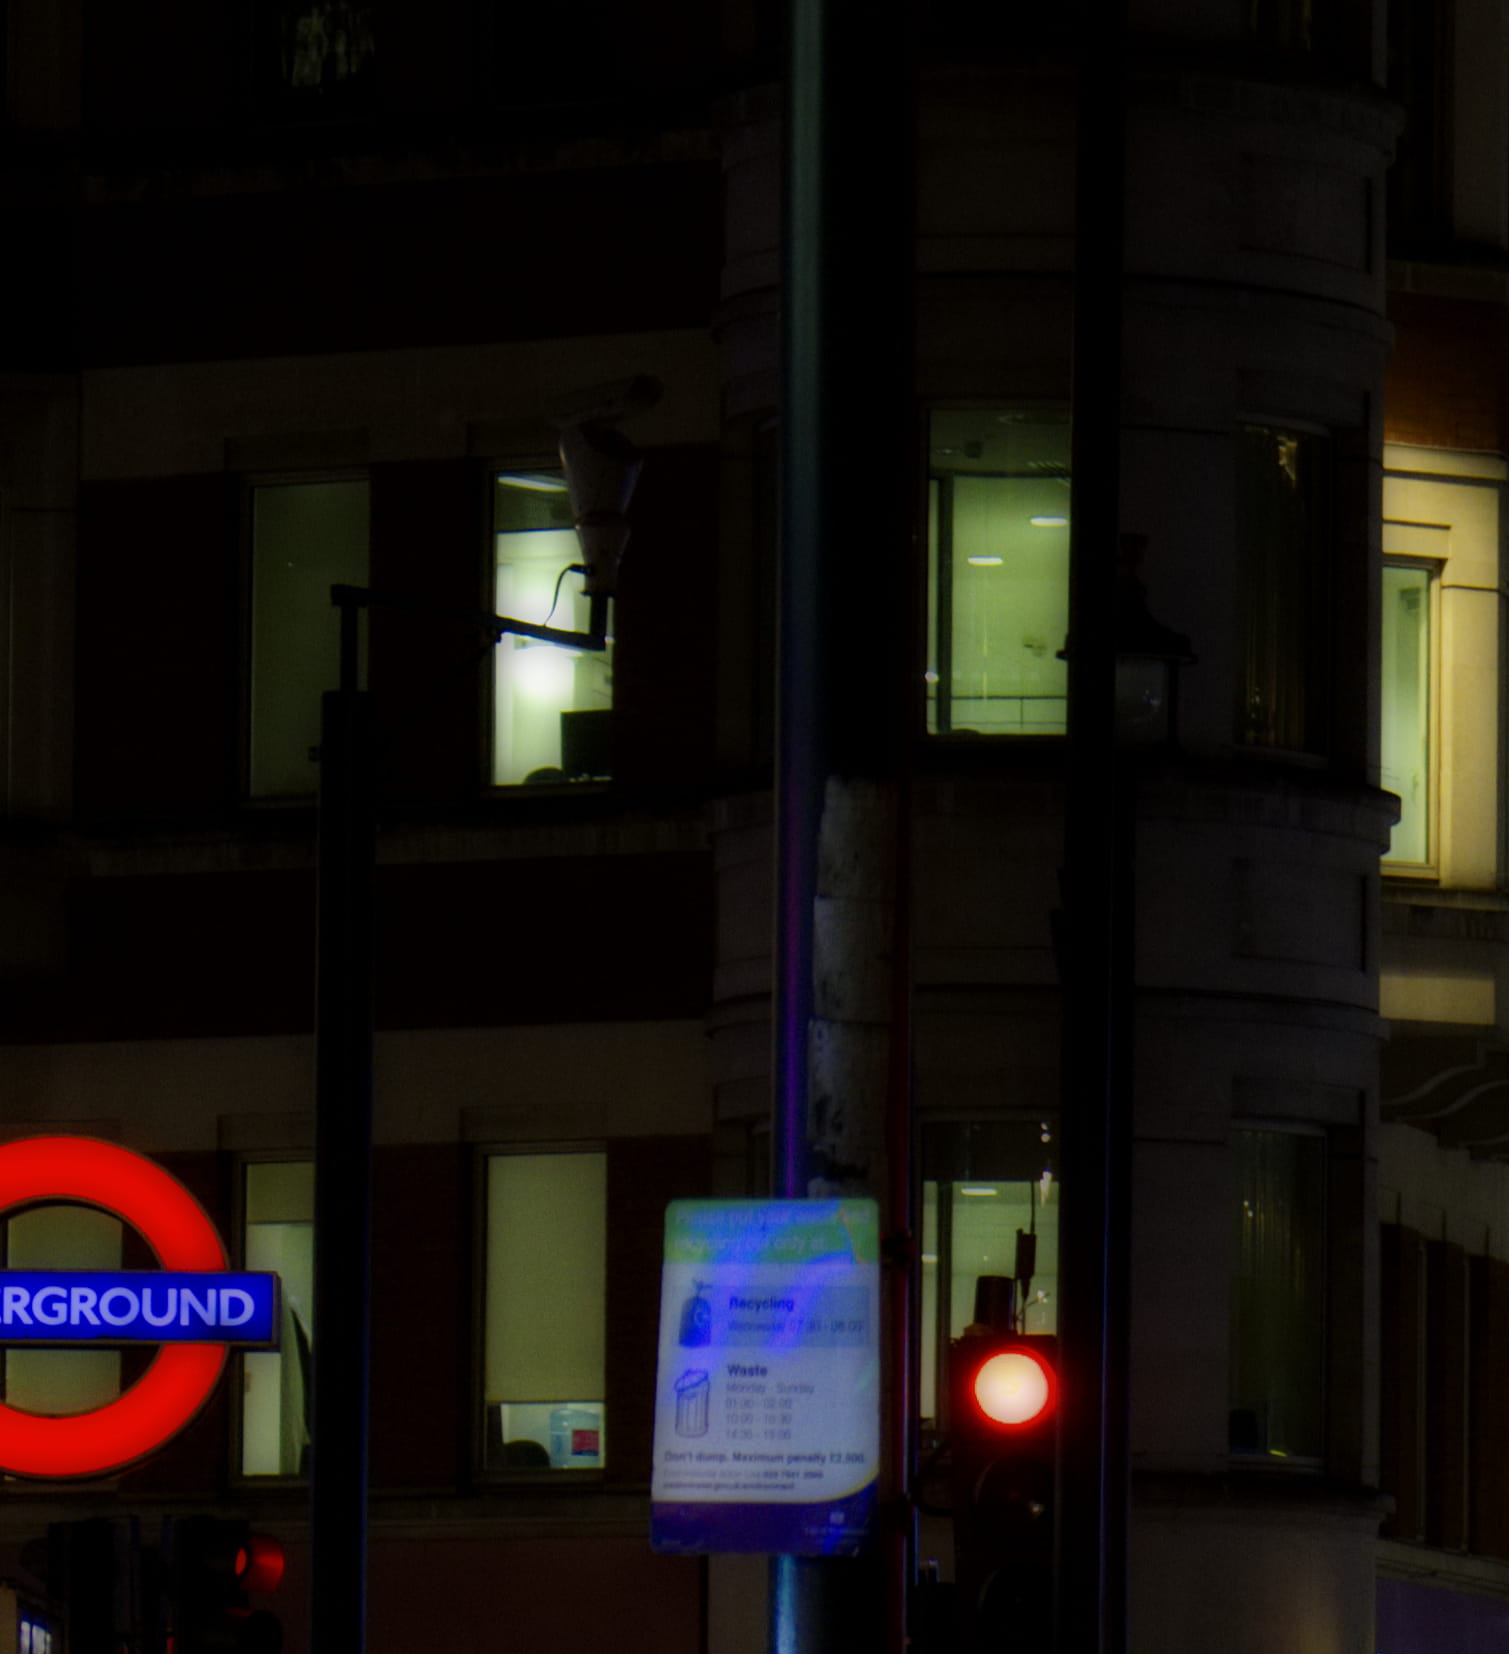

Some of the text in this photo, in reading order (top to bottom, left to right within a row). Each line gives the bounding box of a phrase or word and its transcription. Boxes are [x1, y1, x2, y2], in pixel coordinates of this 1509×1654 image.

[0, 1286, 256, 1327] RGROUND
[728, 1297, 795, 1313] Recycling
[727, 1364, 768, 1377] Waste
